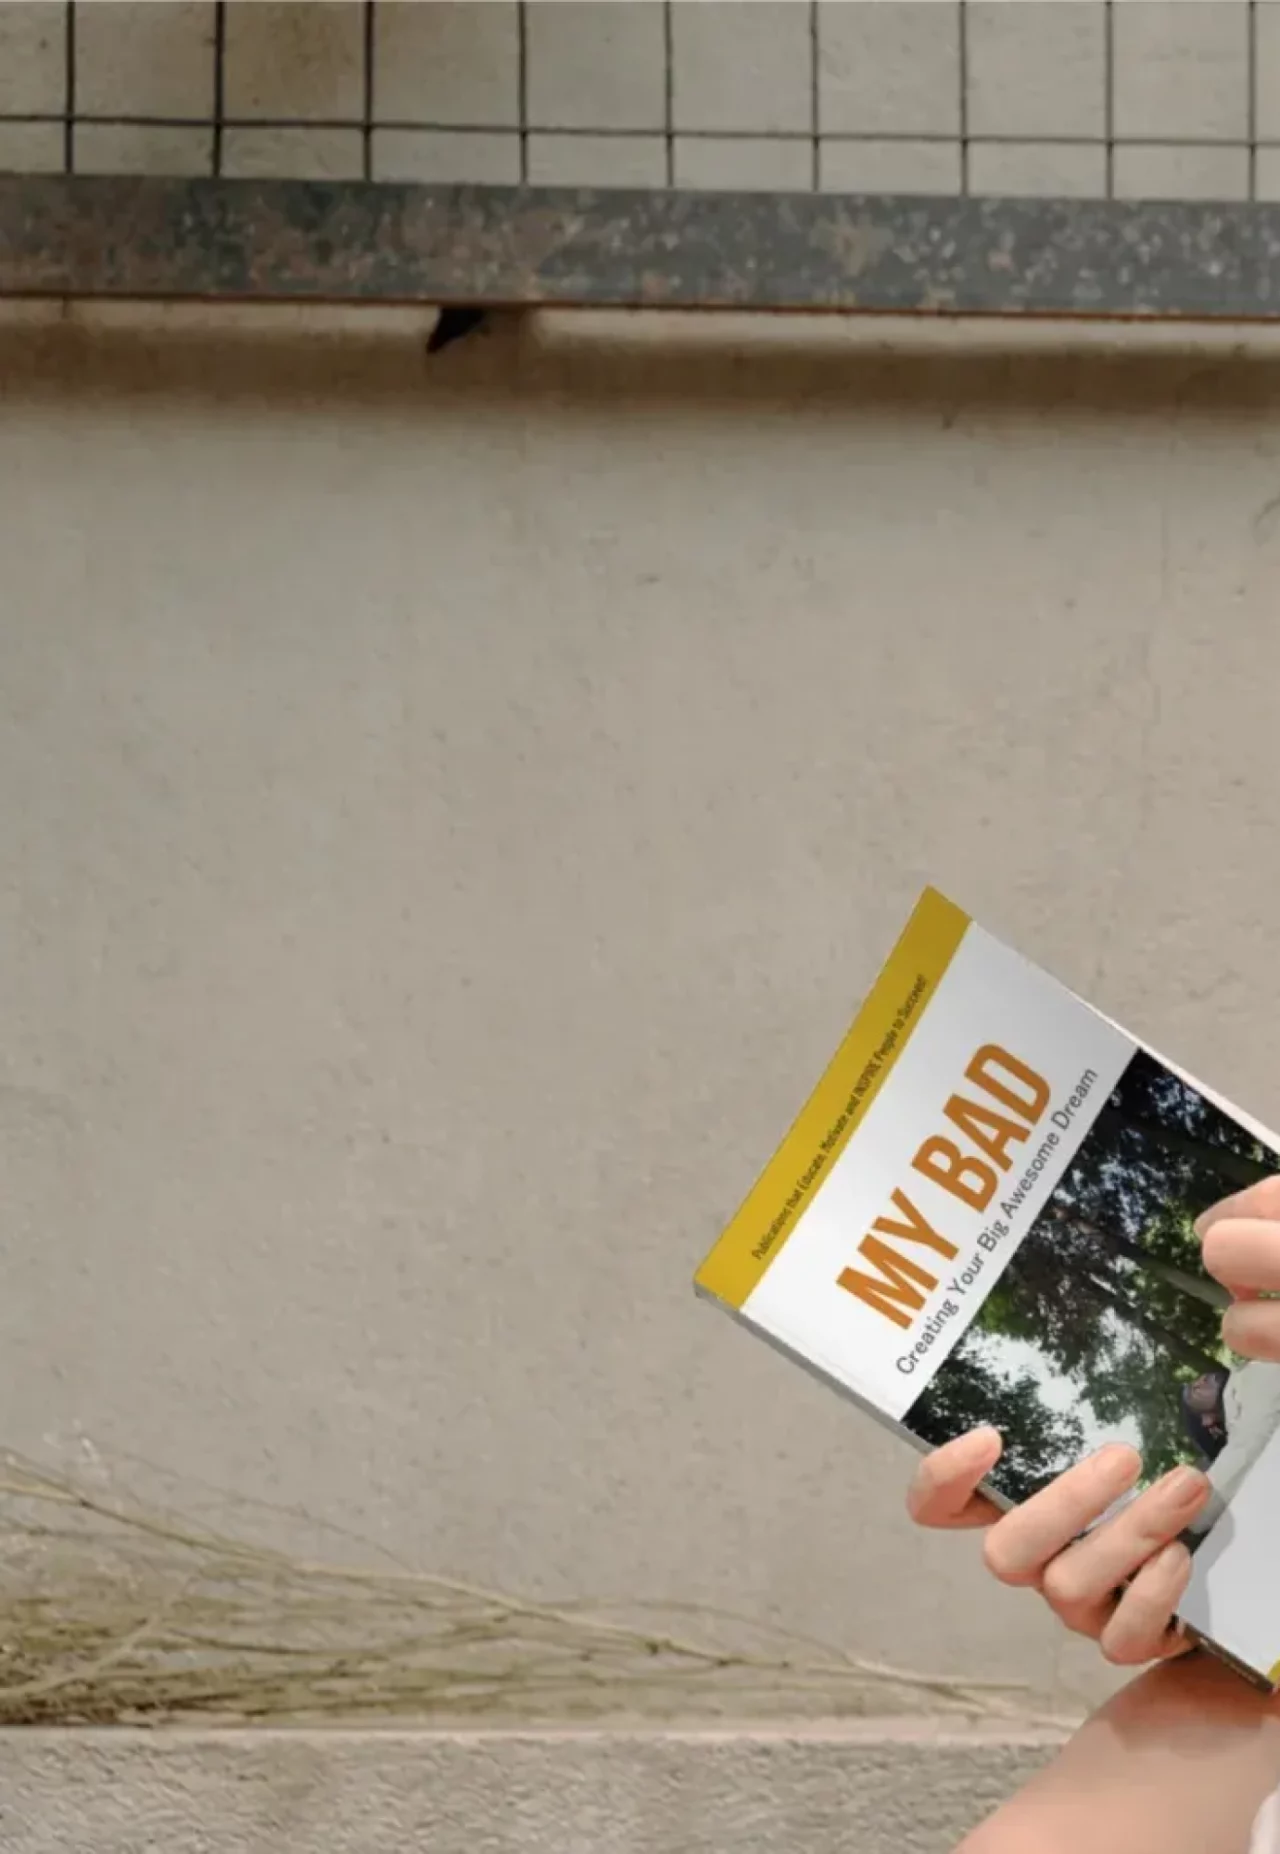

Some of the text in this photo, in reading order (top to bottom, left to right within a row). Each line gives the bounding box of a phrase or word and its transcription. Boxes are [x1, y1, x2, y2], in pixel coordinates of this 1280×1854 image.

[835, 1043, 1051, 1330] MY BAD
[844, 1094, 861, 1116] and
[873, 1029, 899, 1063] People
[892, 1017, 906, 1031] to
[895, 1067, 1099, 1375] Creating Your Big Awesome Dream
